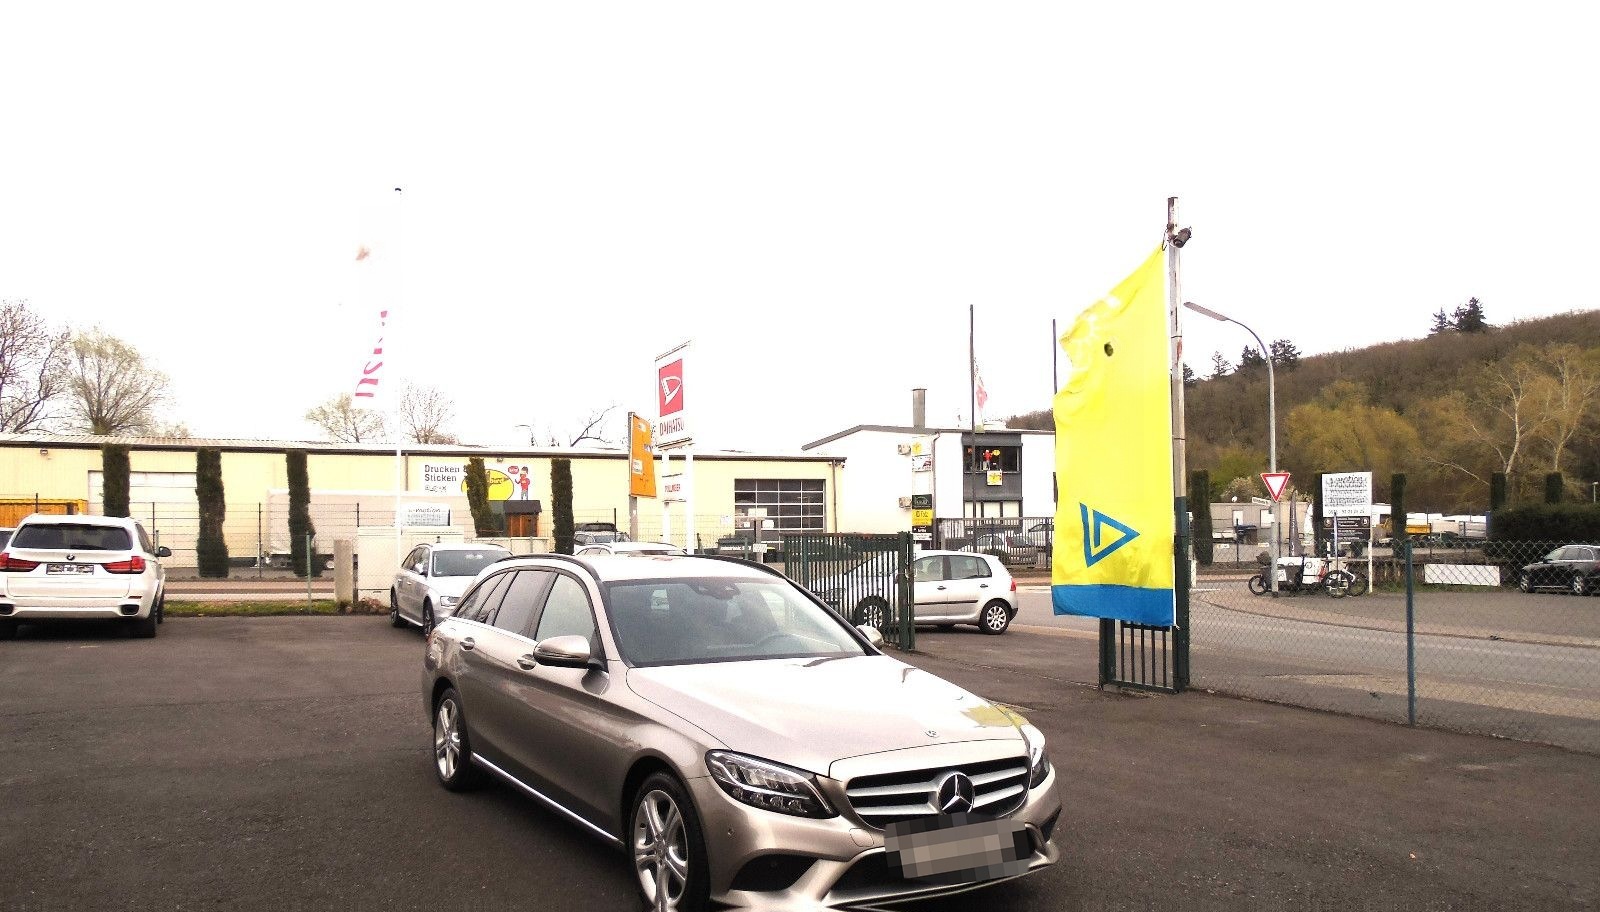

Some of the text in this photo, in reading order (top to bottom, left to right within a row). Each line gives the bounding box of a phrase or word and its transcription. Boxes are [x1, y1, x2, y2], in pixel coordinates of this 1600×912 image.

[660, 418, 684, 436] DAIHATSU
[424, 464, 460, 473] Drucken
[424, 474, 457, 482] Sticken
